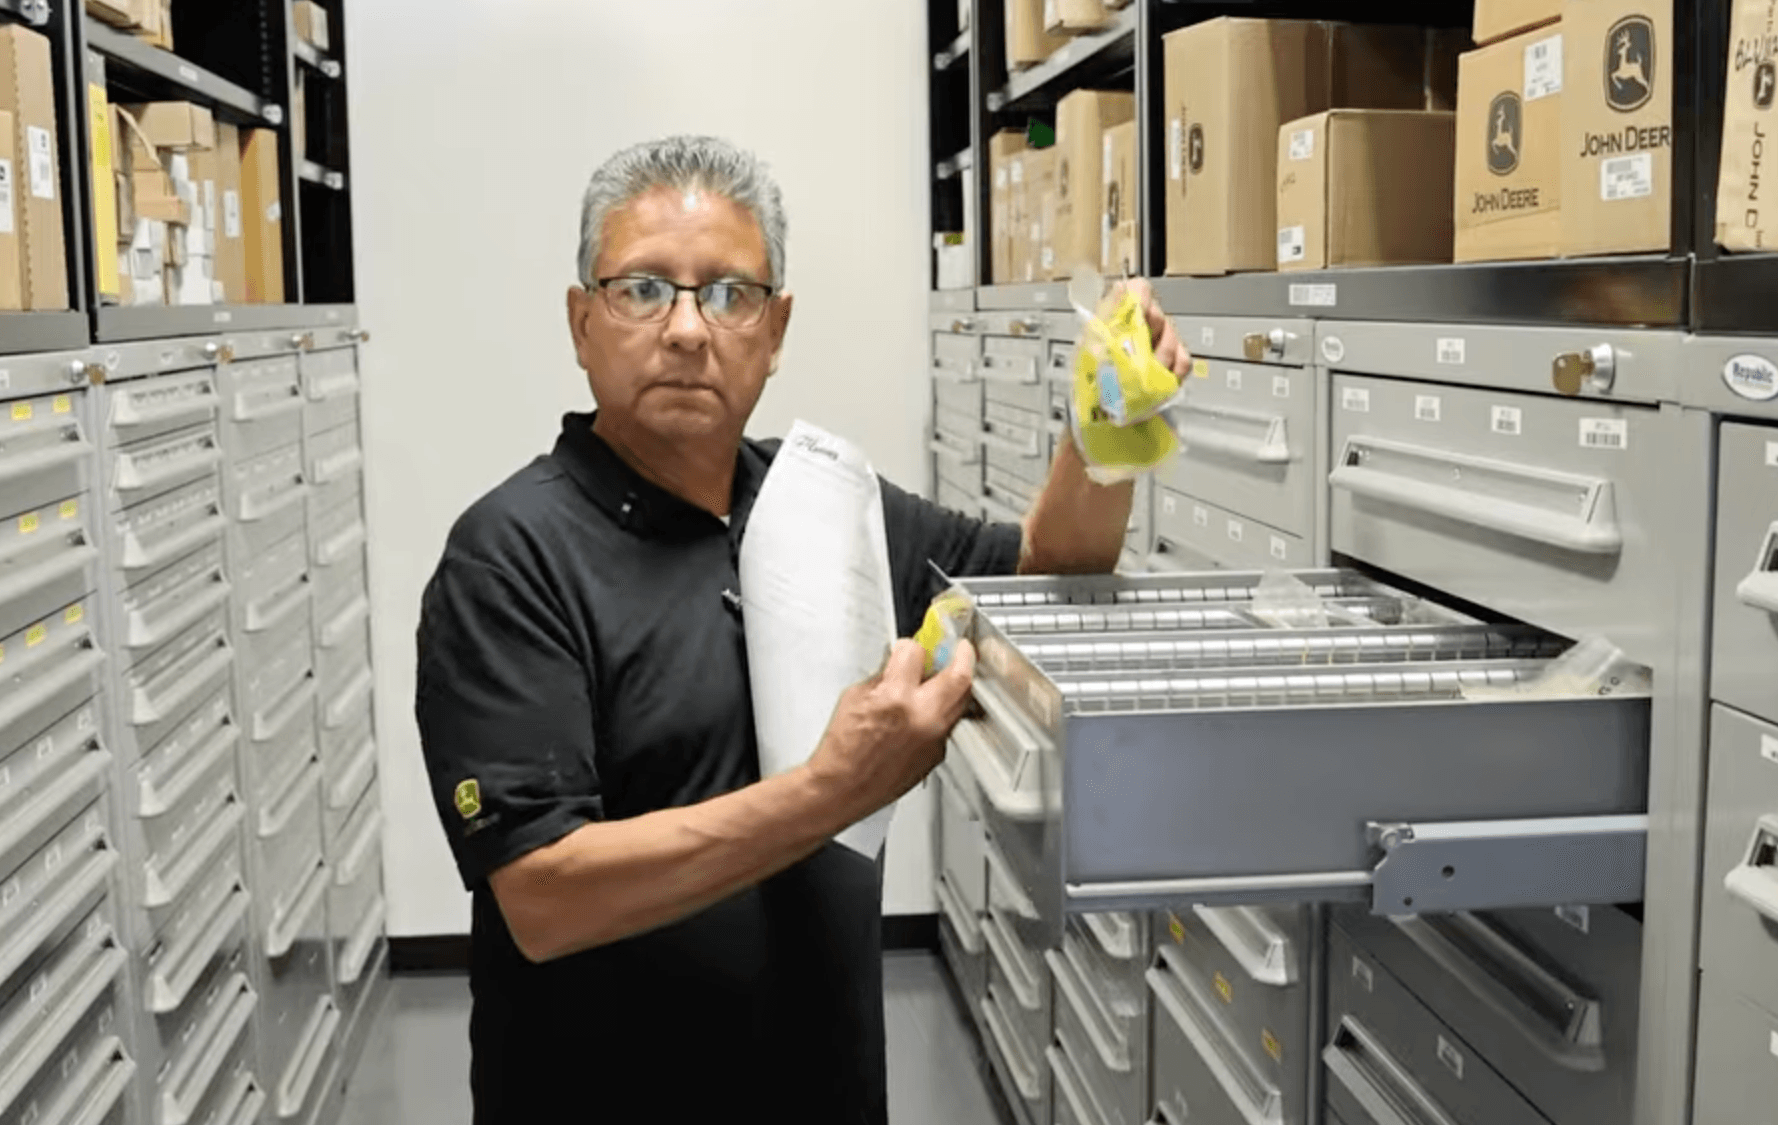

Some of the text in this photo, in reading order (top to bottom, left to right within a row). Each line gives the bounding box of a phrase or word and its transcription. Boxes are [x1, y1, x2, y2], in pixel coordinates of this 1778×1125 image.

[1580, 126, 1671, 157] JOHN DEER
[1749, 121, 1765, 201] JOHN
[1472, 188, 1539, 214] JOHN DEERE
